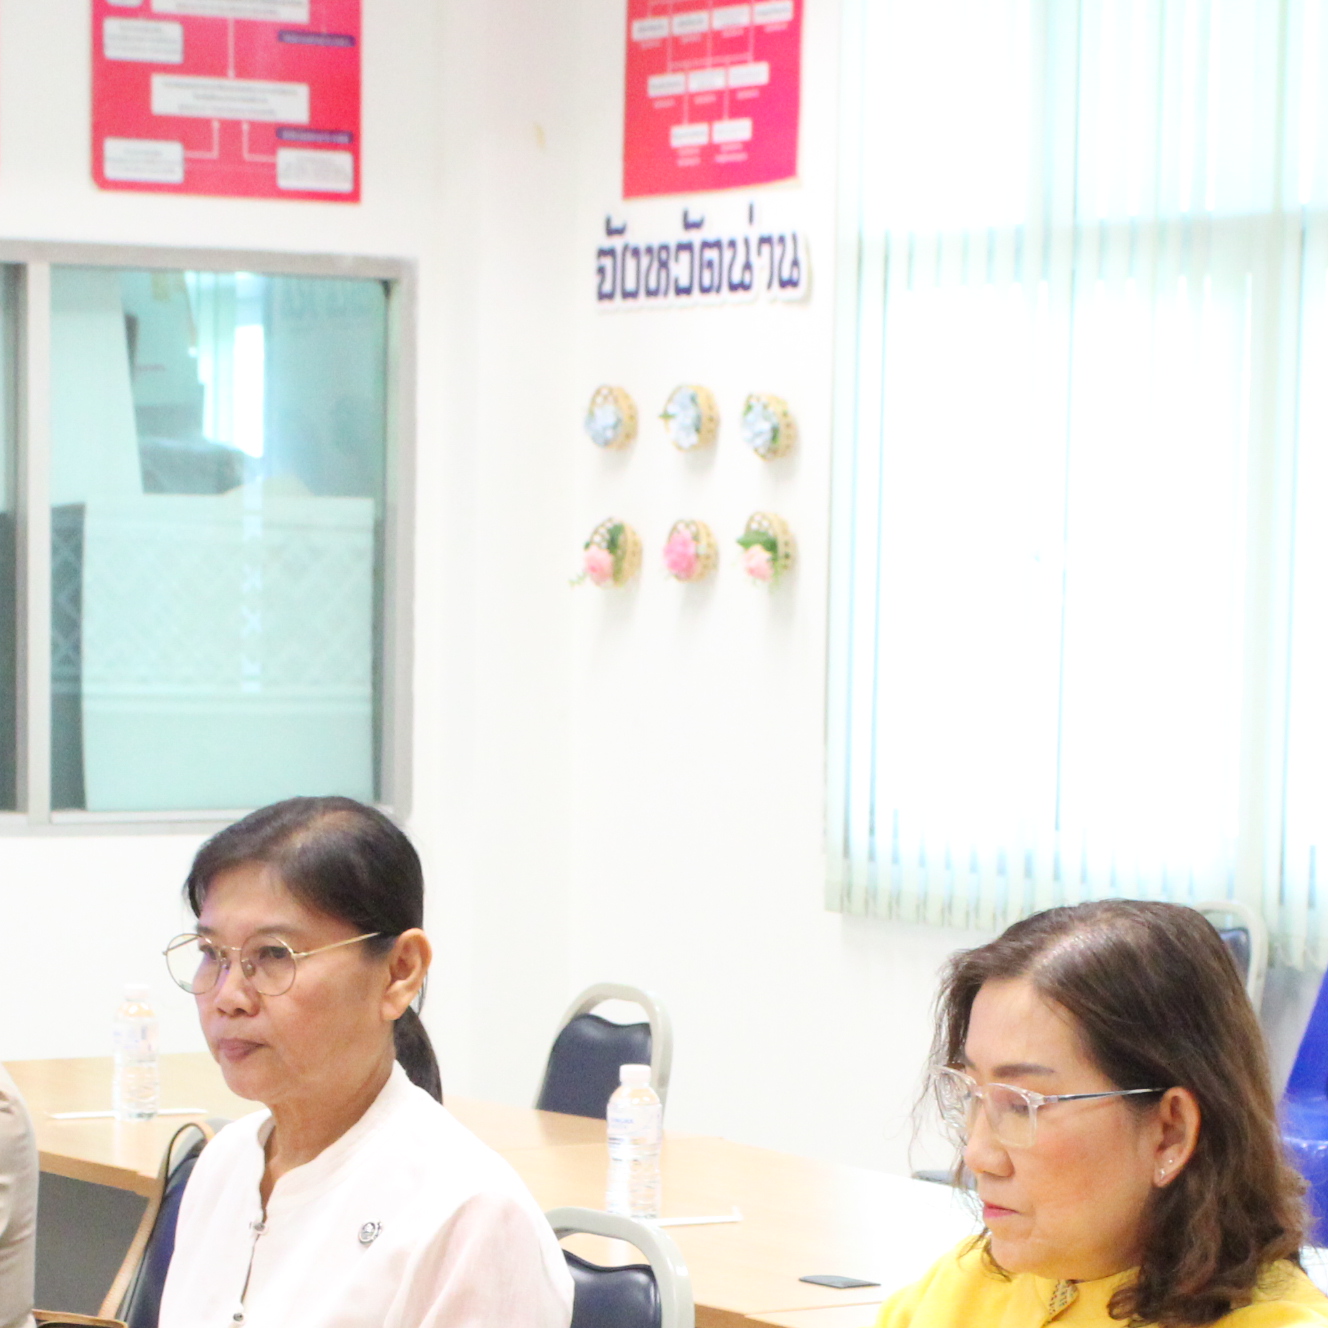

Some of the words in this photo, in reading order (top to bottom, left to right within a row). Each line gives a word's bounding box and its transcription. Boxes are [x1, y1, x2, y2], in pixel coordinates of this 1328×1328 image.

[595, 201, 802, 302] จังหวัดน่าน
